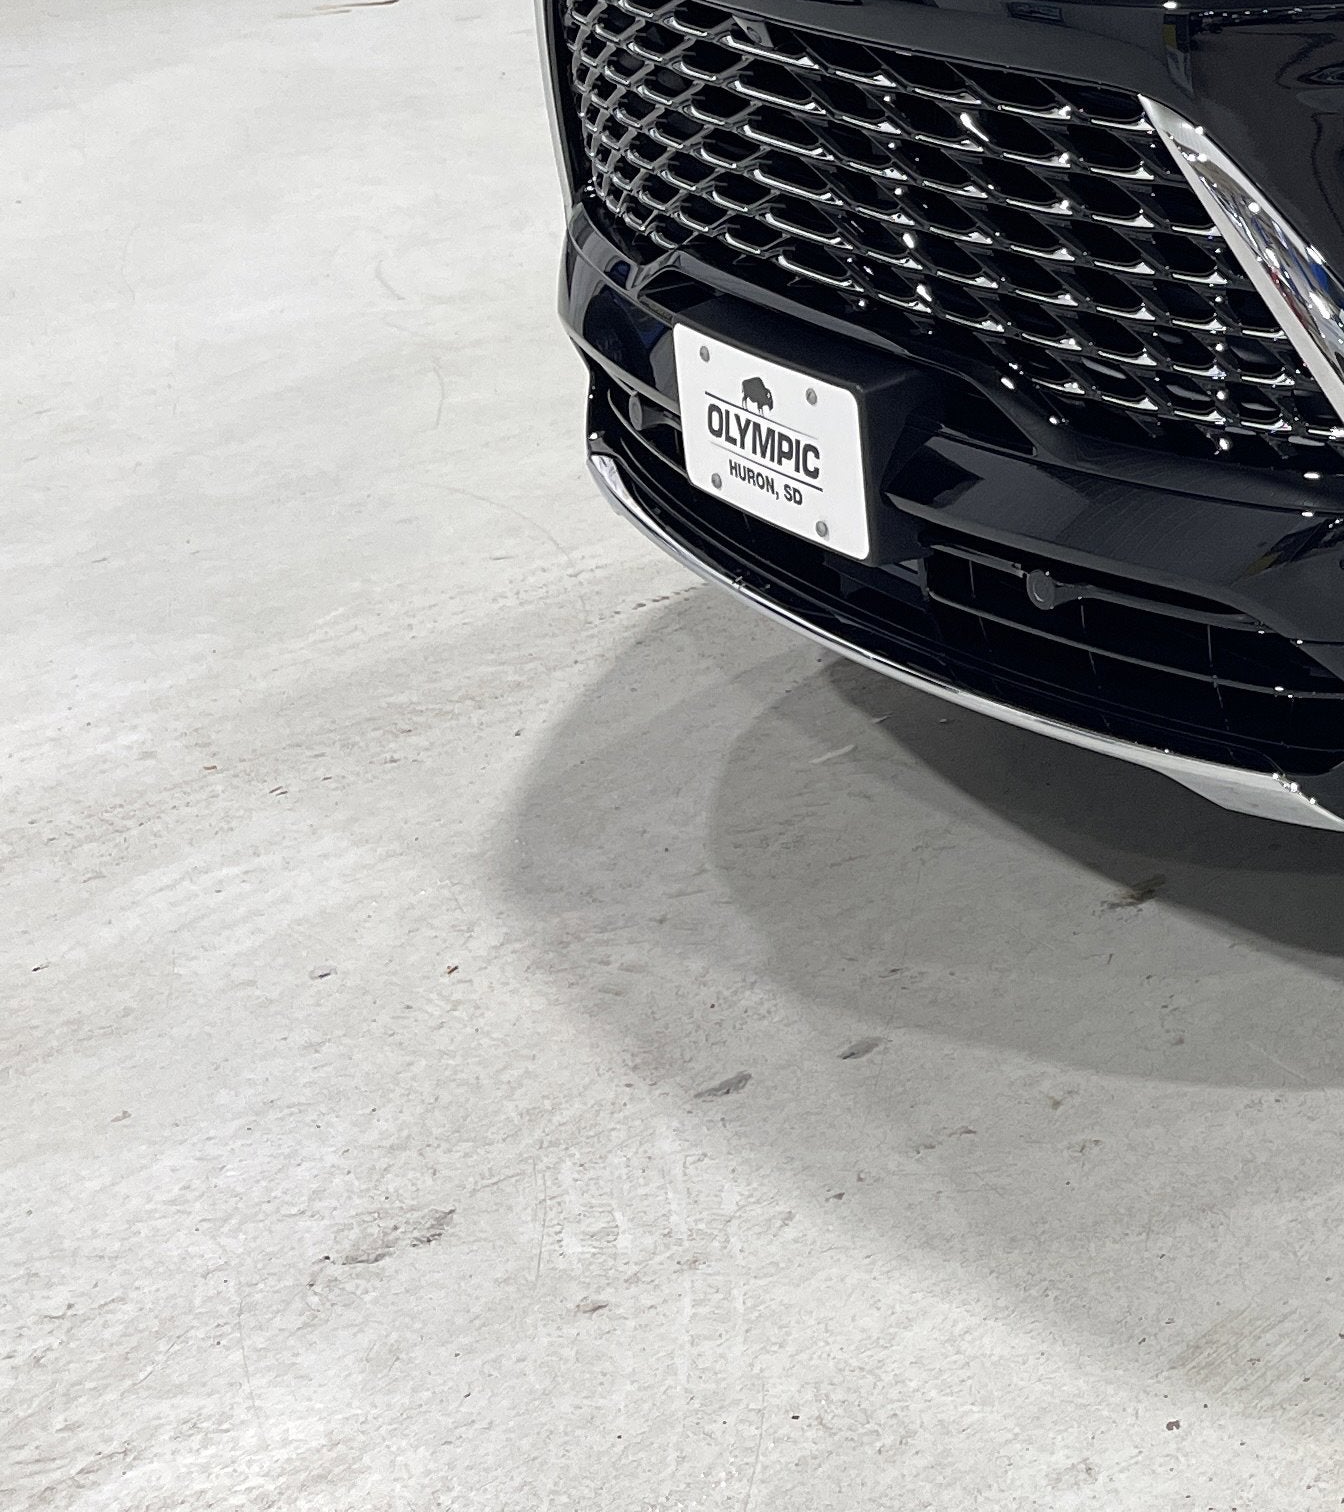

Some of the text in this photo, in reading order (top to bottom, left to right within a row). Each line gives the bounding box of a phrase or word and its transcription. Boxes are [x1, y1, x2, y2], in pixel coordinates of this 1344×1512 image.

[707, 403, 820, 480] OLYMPIC
[729, 459, 803, 506] HURON, SD
